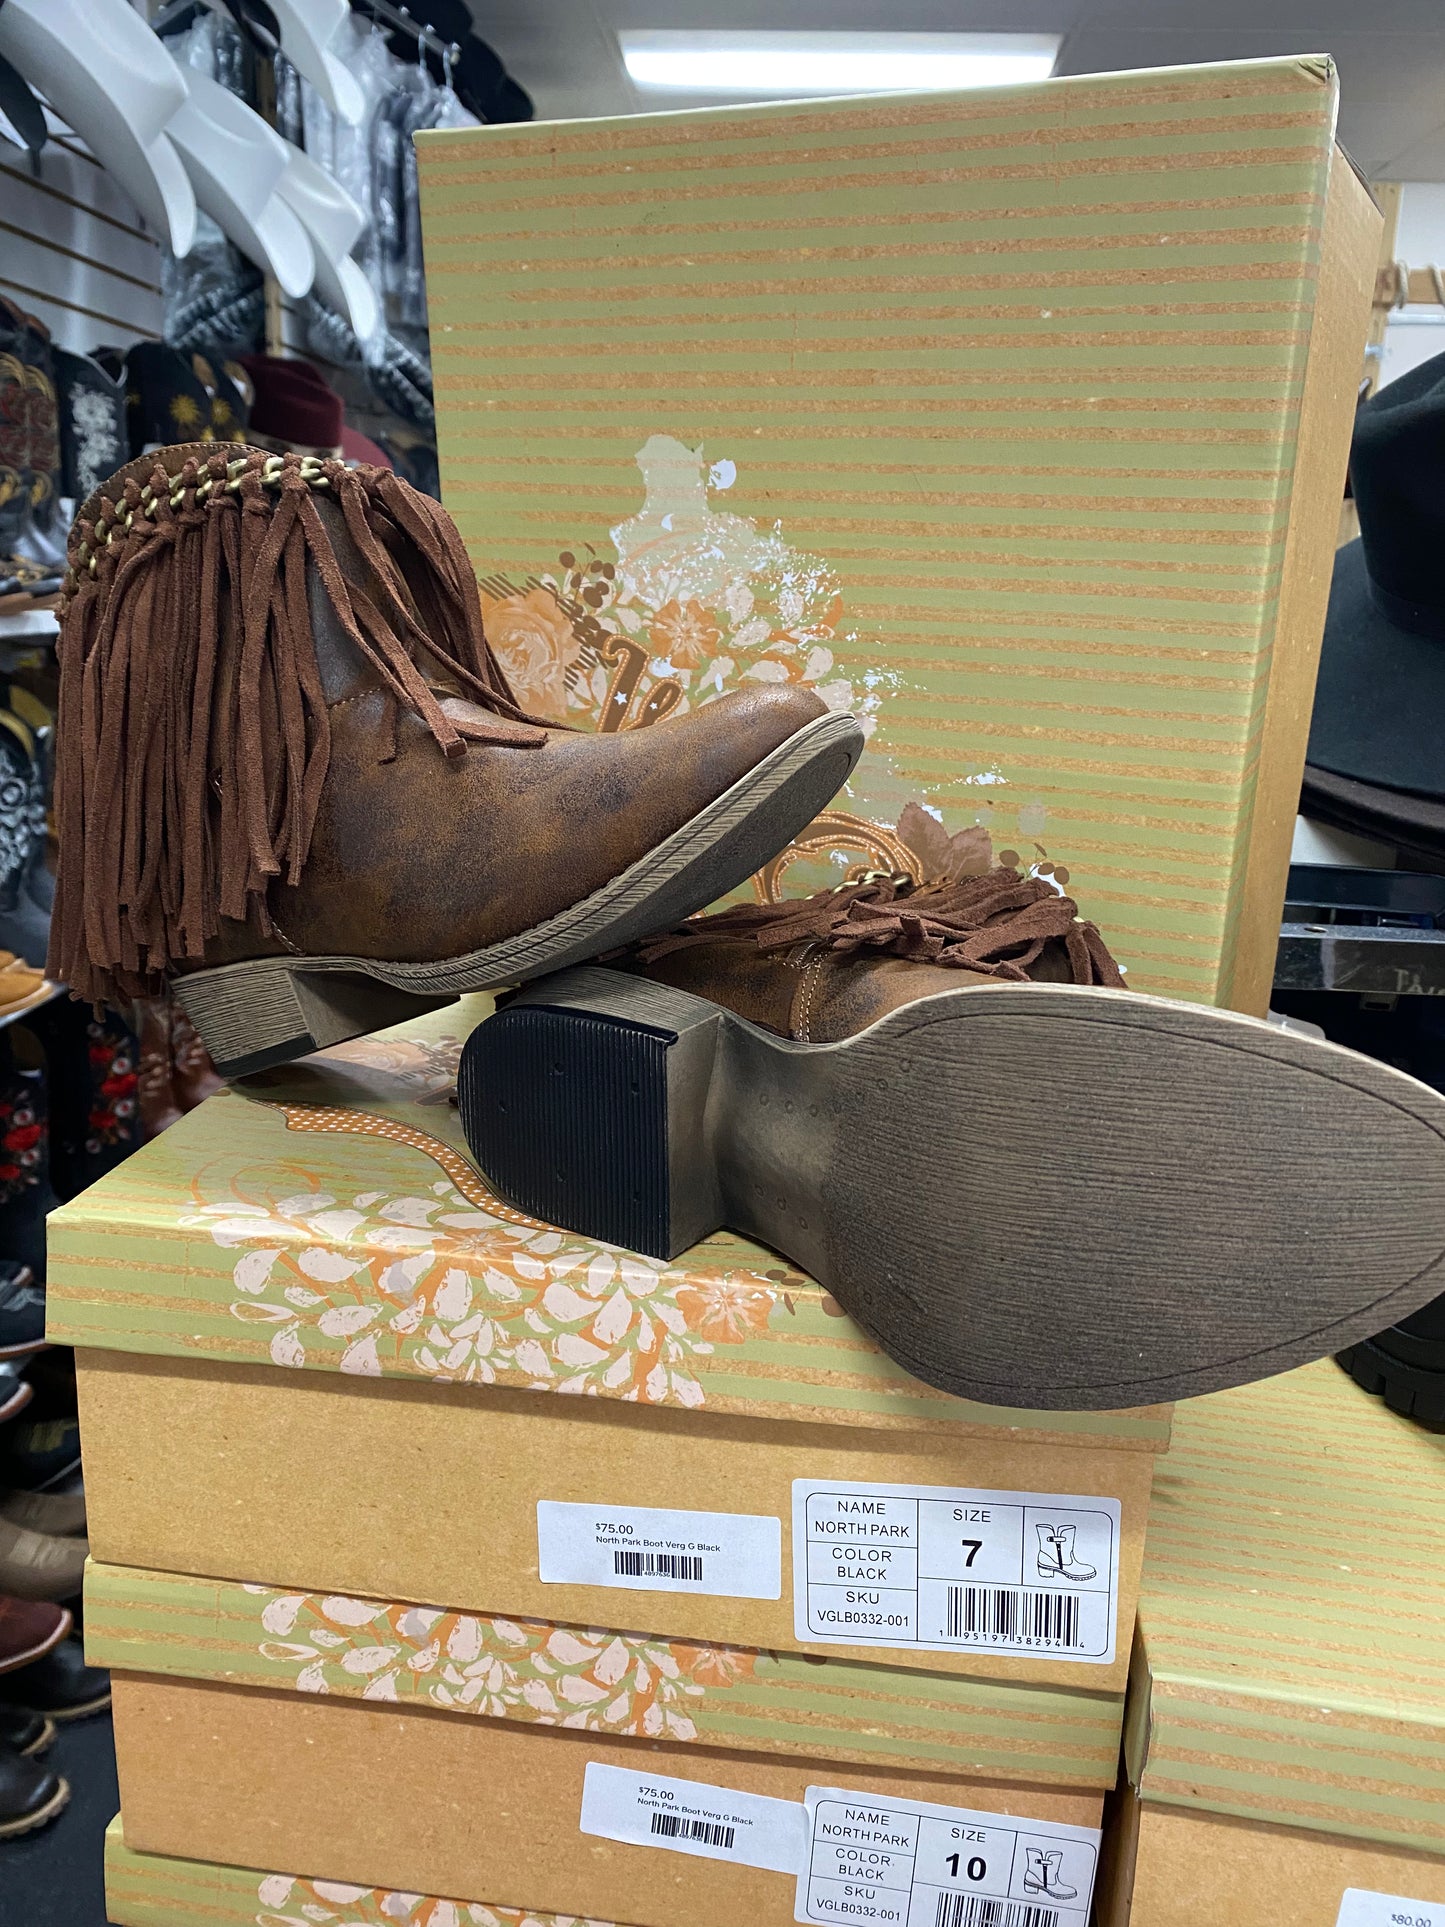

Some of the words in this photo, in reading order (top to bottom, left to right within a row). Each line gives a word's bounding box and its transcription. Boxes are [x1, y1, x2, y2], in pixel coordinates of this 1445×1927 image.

[838, 1501, 886, 1515] NAME
[953, 1508, 991, 1523] SIZE
[595, 1523, 634, 1535] $75.00
[815, 1520, 867, 1535] NORTH
[870, 1524, 910, 1538] PARK
[595, 1535, 620, 1545] North
[622, 1537, 641, 1546] Park
[643, 1539, 664, 1548] Boot
[665, 1541, 686, 1550] Verg
[688, 1542, 695, 1550] G
[697, 1543, 721, 1552] Black
[832, 1547, 892, 1562] COLOR
[961, 1539, 983, 1567] 7
[837, 1566, 887, 1580] BLACK
[846, 1591, 880, 1605] SKU
[817, 1609, 909, 1627] VGLB0332-001
[639, 1786, 674, 1801] $75.00
[637, 1797, 660, 1808] North
[661, 1802, 680, 1811] Park
[681, 1806, 700, 1815] Boot
[702, 1810, 721, 1820] Verg
[731, 1815, 754, 1826] Black
[845, 1809, 890, 1826] NAME
[822, 1823, 870, 1841] NORTH
[873, 1832, 910, 1848] PARK
[950, 1827, 987, 1843] SIZE
[835, 1848, 892, 1866] COLOR
[838, 1864, 885, 1881] BLACK
[945, 1853, 987, 1881] 10
[844, 1886, 876, 1900] SKU
[816, 1898, 900, 1921] VGLB0332-001
[1391, 1913, 1432, 1927] $80.00
